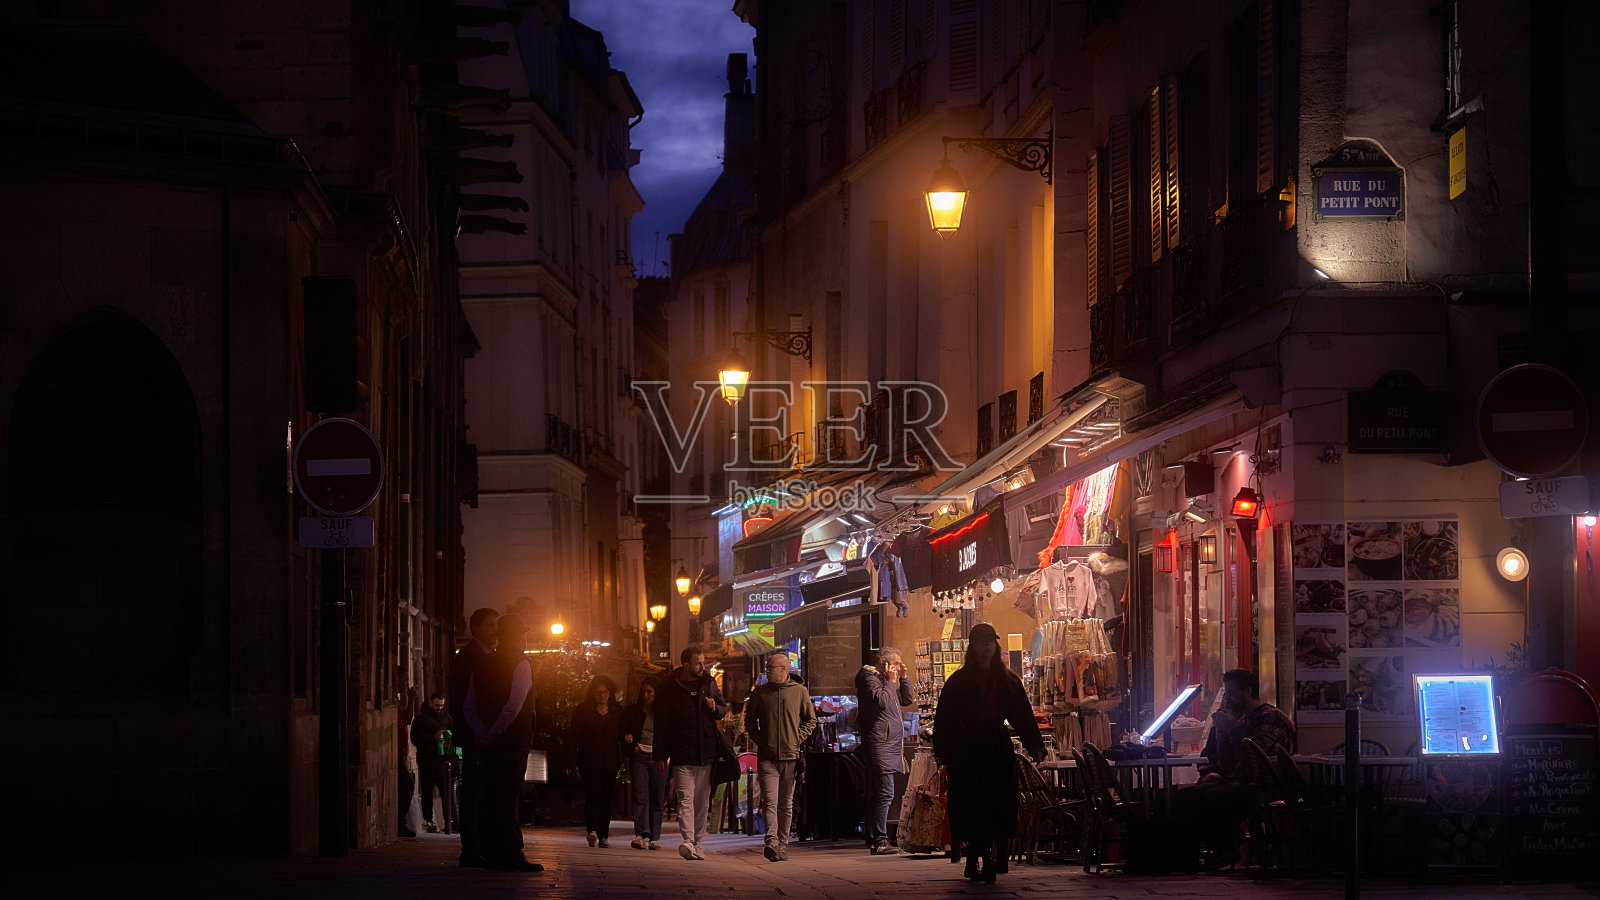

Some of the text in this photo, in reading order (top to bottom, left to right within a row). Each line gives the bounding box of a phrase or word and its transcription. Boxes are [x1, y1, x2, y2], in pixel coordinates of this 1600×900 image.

[1333, 180, 1386, 192] RUE DU
[1321, 197, 1399, 208] PETIT PONT
[1387, 407, 1409, 418] RUE
[1359, 427, 1438, 439] DU PETIT PONT
[1525, 480, 1562, 495] SAUF
[321, 519, 352, 530] SAUF
[748, 592, 785, 602] CRÊPES
[748, 603, 786, 612] MAISON
